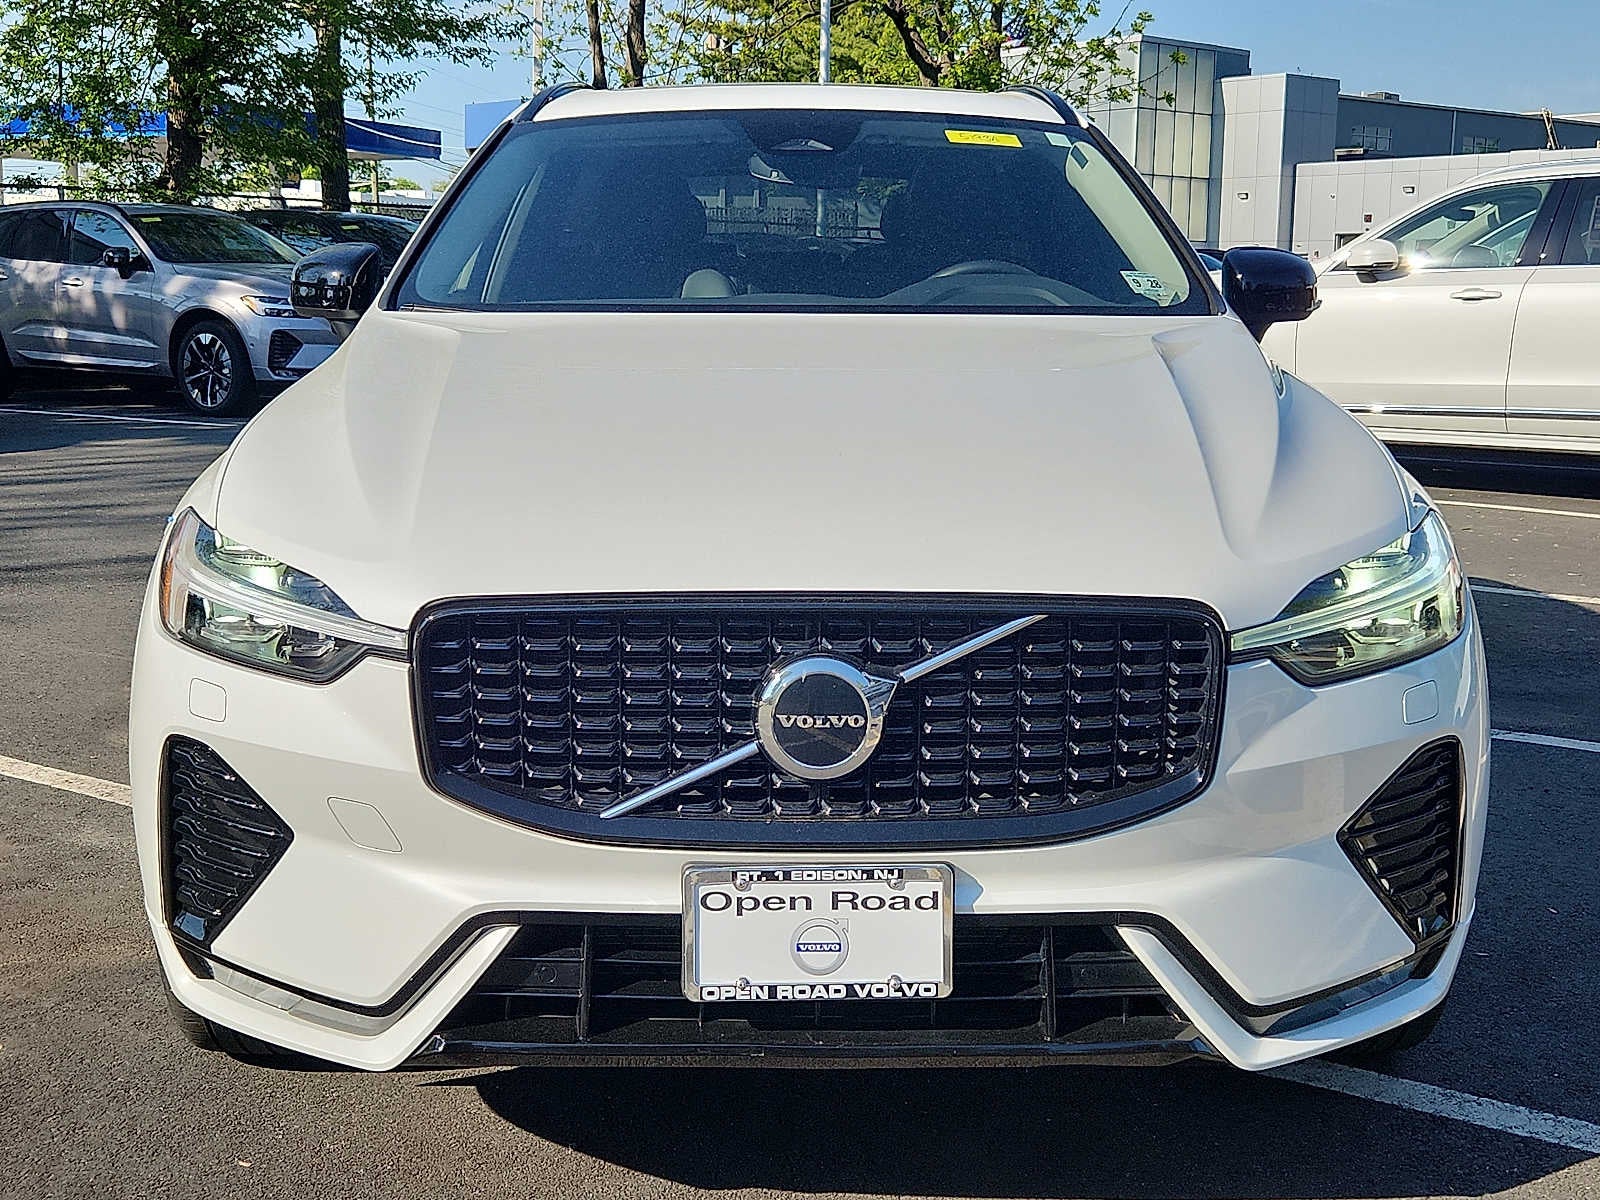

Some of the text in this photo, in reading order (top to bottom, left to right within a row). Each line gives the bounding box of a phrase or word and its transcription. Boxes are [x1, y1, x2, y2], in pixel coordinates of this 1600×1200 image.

[1131, 278, 1162, 289] 9 28
[776, 714, 865, 729] VOLVO
[736, 868, 899, 882] RT. 1 EDISON, NJ
[700, 890, 939, 917] Open Road
[798, 943, 840, 951] VOLVO
[701, 983, 937, 1000] OPEN ROAD VOLVO
